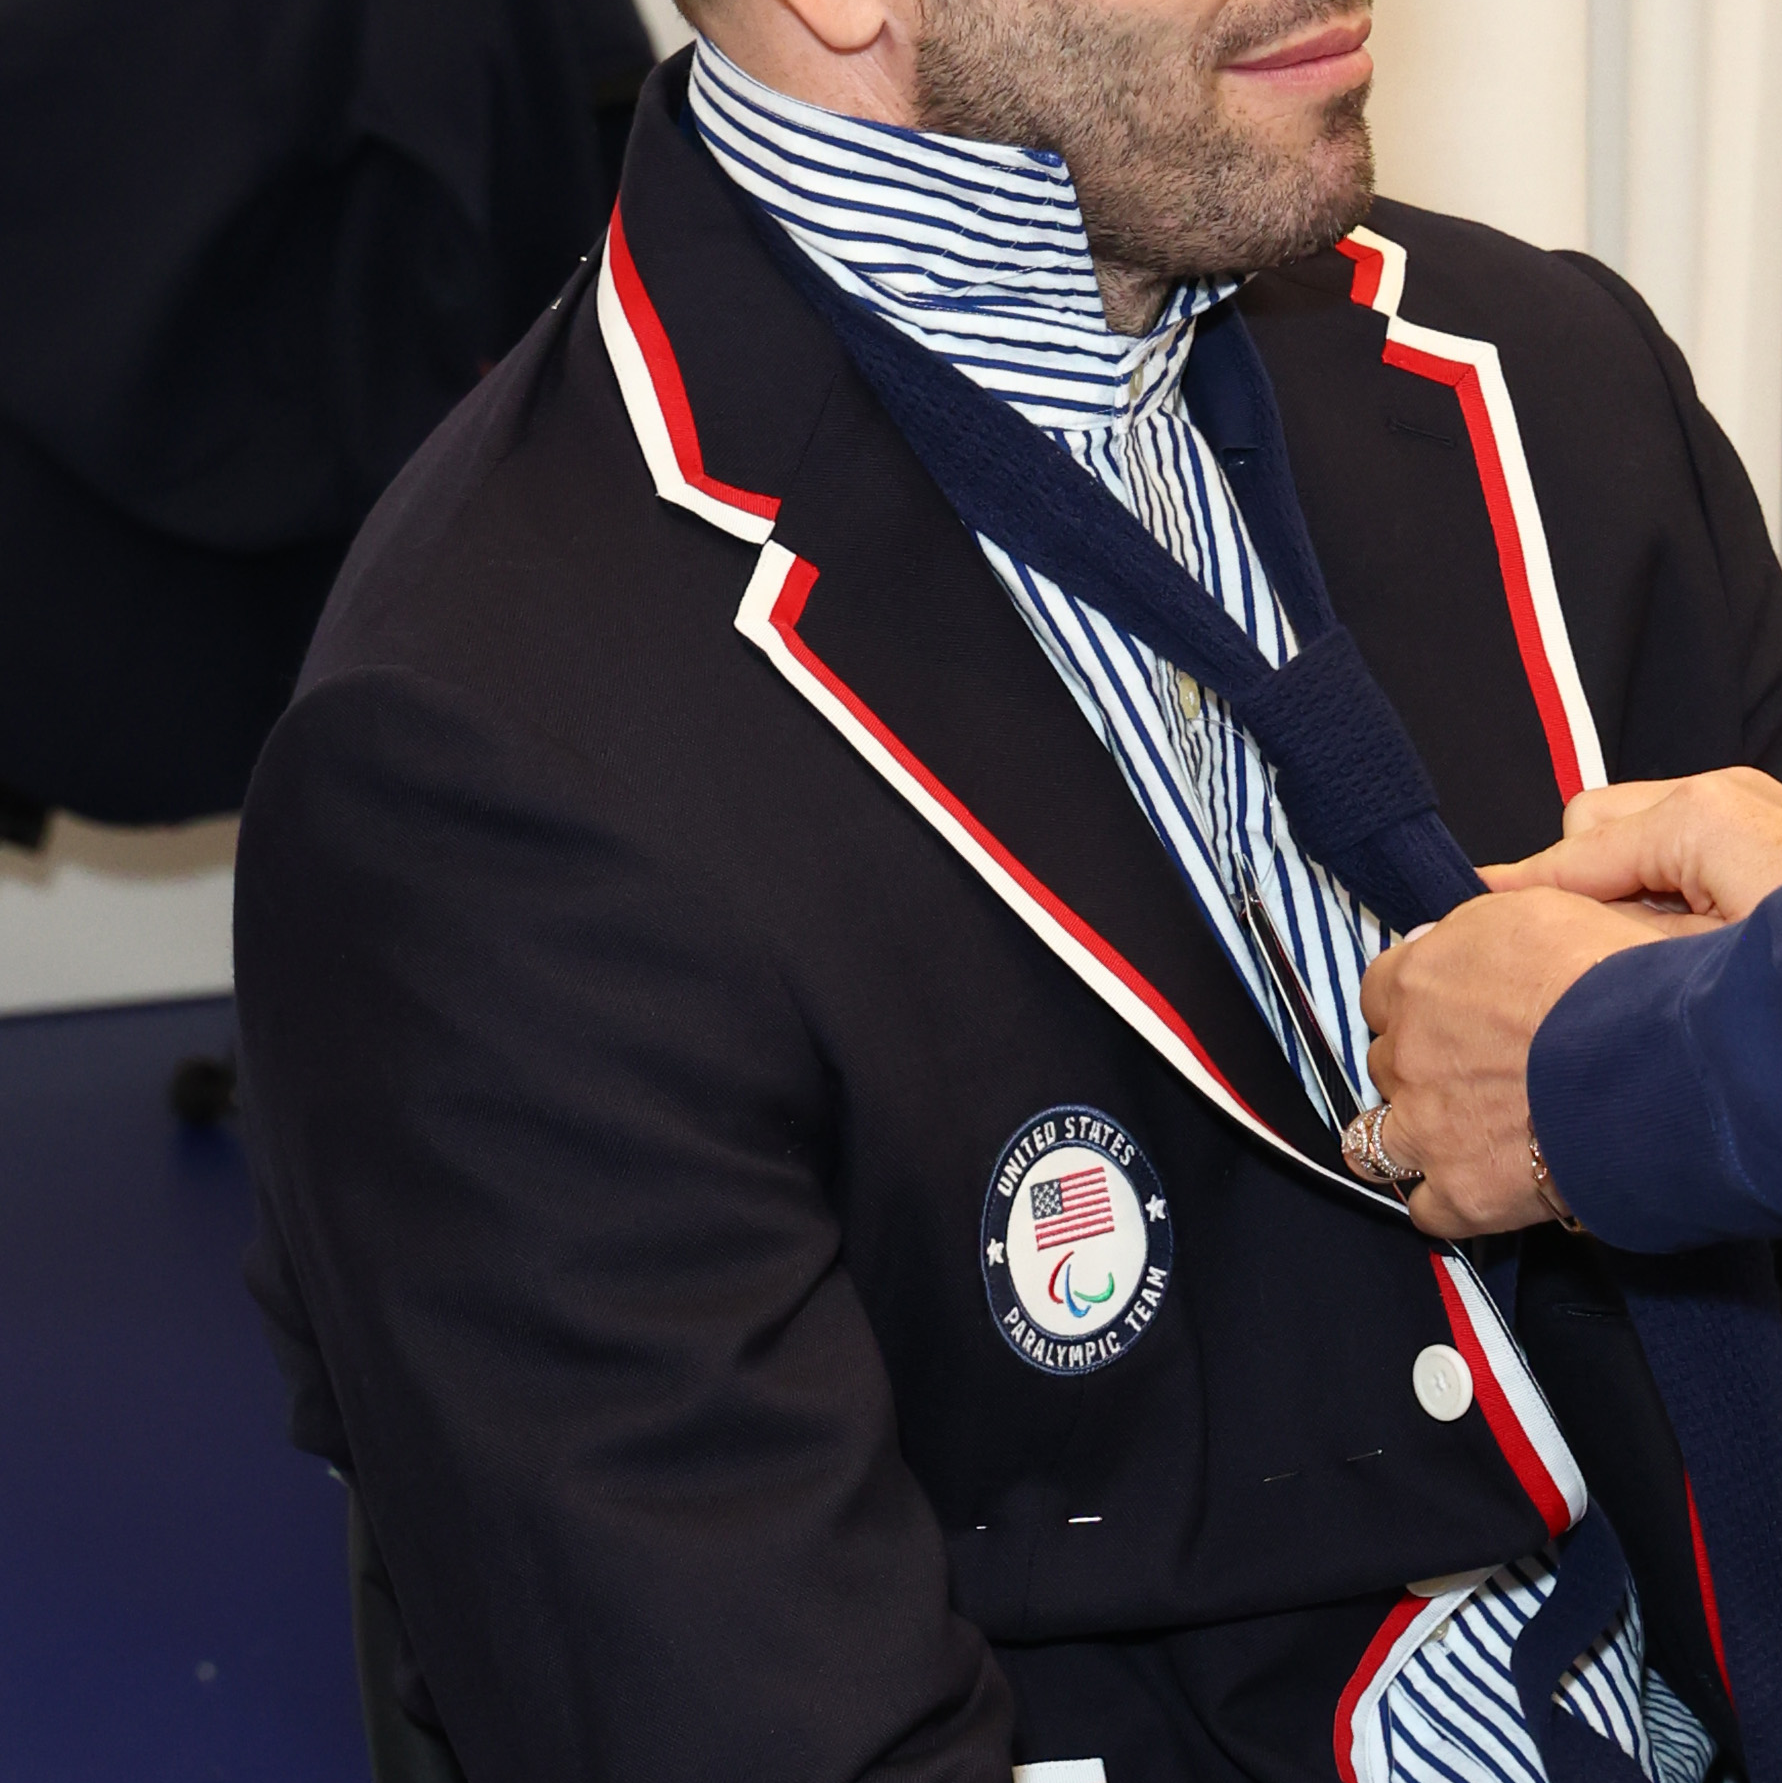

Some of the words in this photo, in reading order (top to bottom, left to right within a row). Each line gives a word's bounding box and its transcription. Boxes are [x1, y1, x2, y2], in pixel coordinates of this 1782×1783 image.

[997, 1120, 1057, 1198] UNITED
[1064, 1115, 1136, 1167] STATES
[1003, 1306, 1123, 1368] PARALYMPIC
[1124, 1265, 1168, 1332] TEAM
